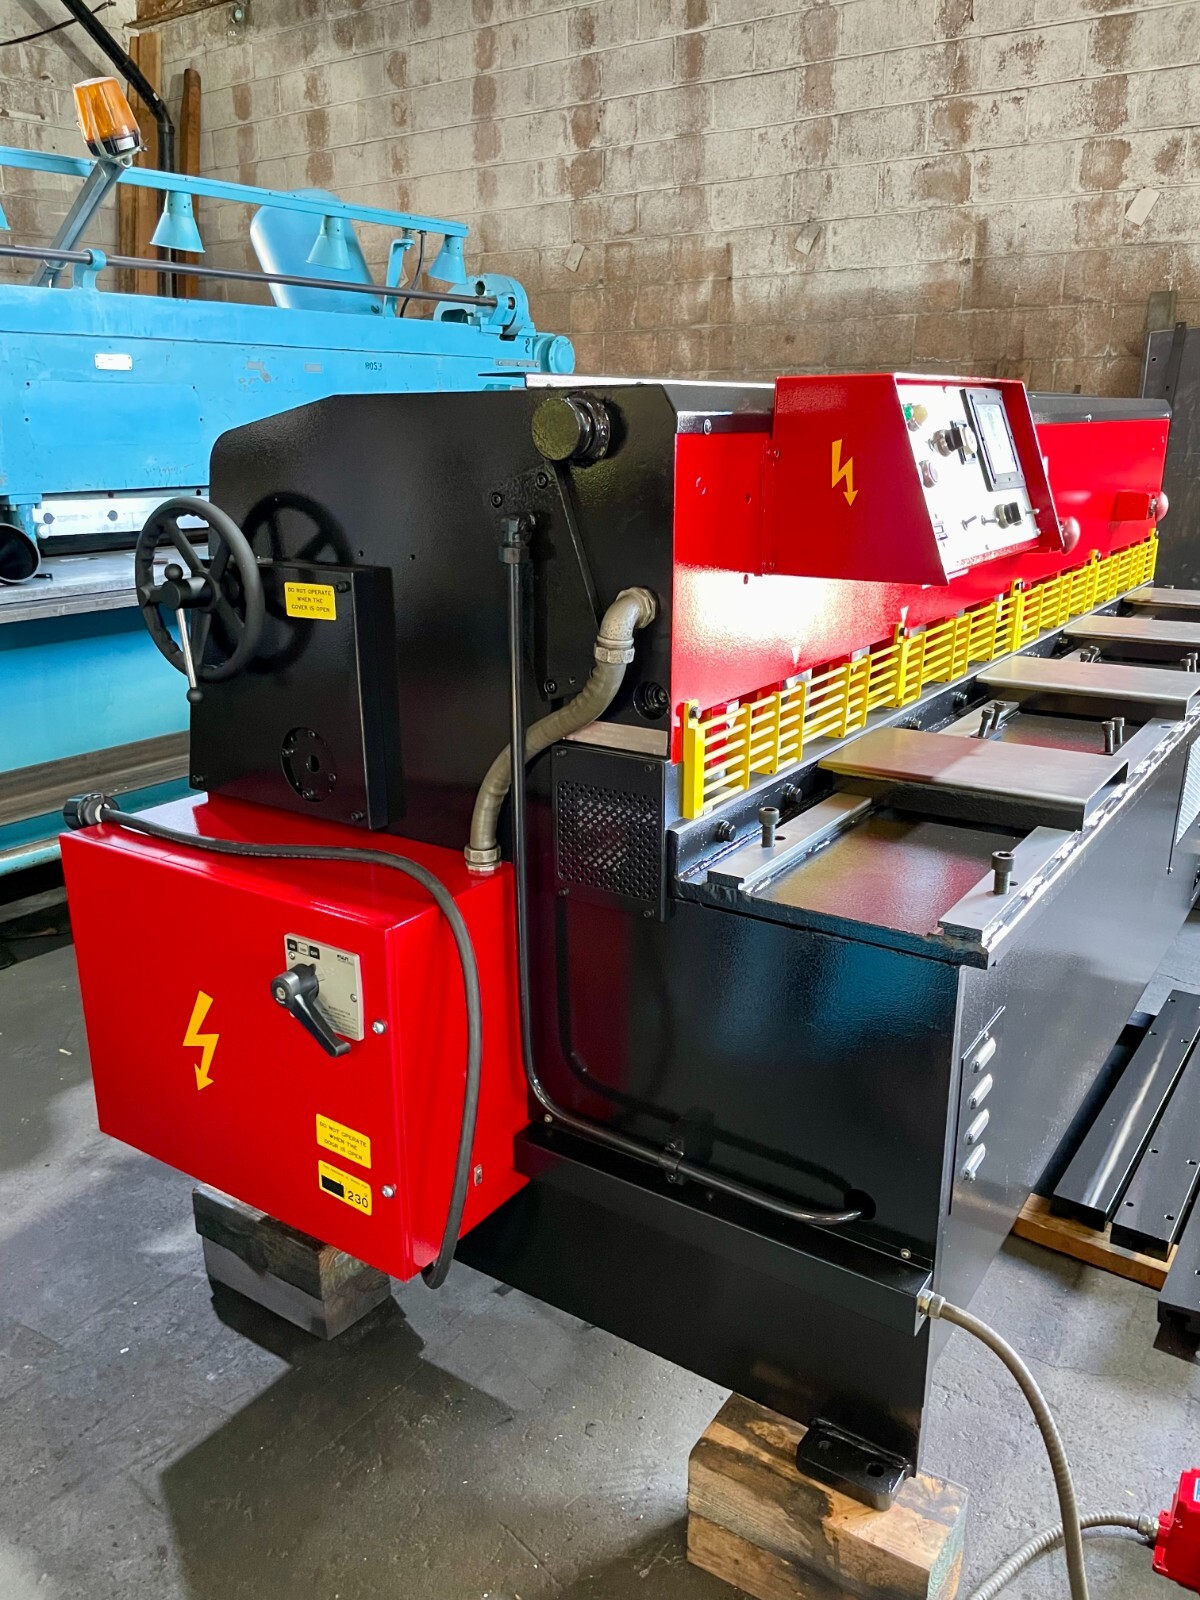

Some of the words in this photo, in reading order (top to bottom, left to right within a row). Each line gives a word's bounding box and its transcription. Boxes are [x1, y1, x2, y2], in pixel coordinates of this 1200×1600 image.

[328, 1126, 339, 1134] NOT
[341, 1132, 367, 1148] OPERATE
[329, 1134, 344, 1144] WHEN
[346, 1142, 358, 1151] THE
[324, 1139, 338, 1149] DOOR
[348, 1151, 362, 1160] OPEN
[348, 1190, 368, 1208] 230
